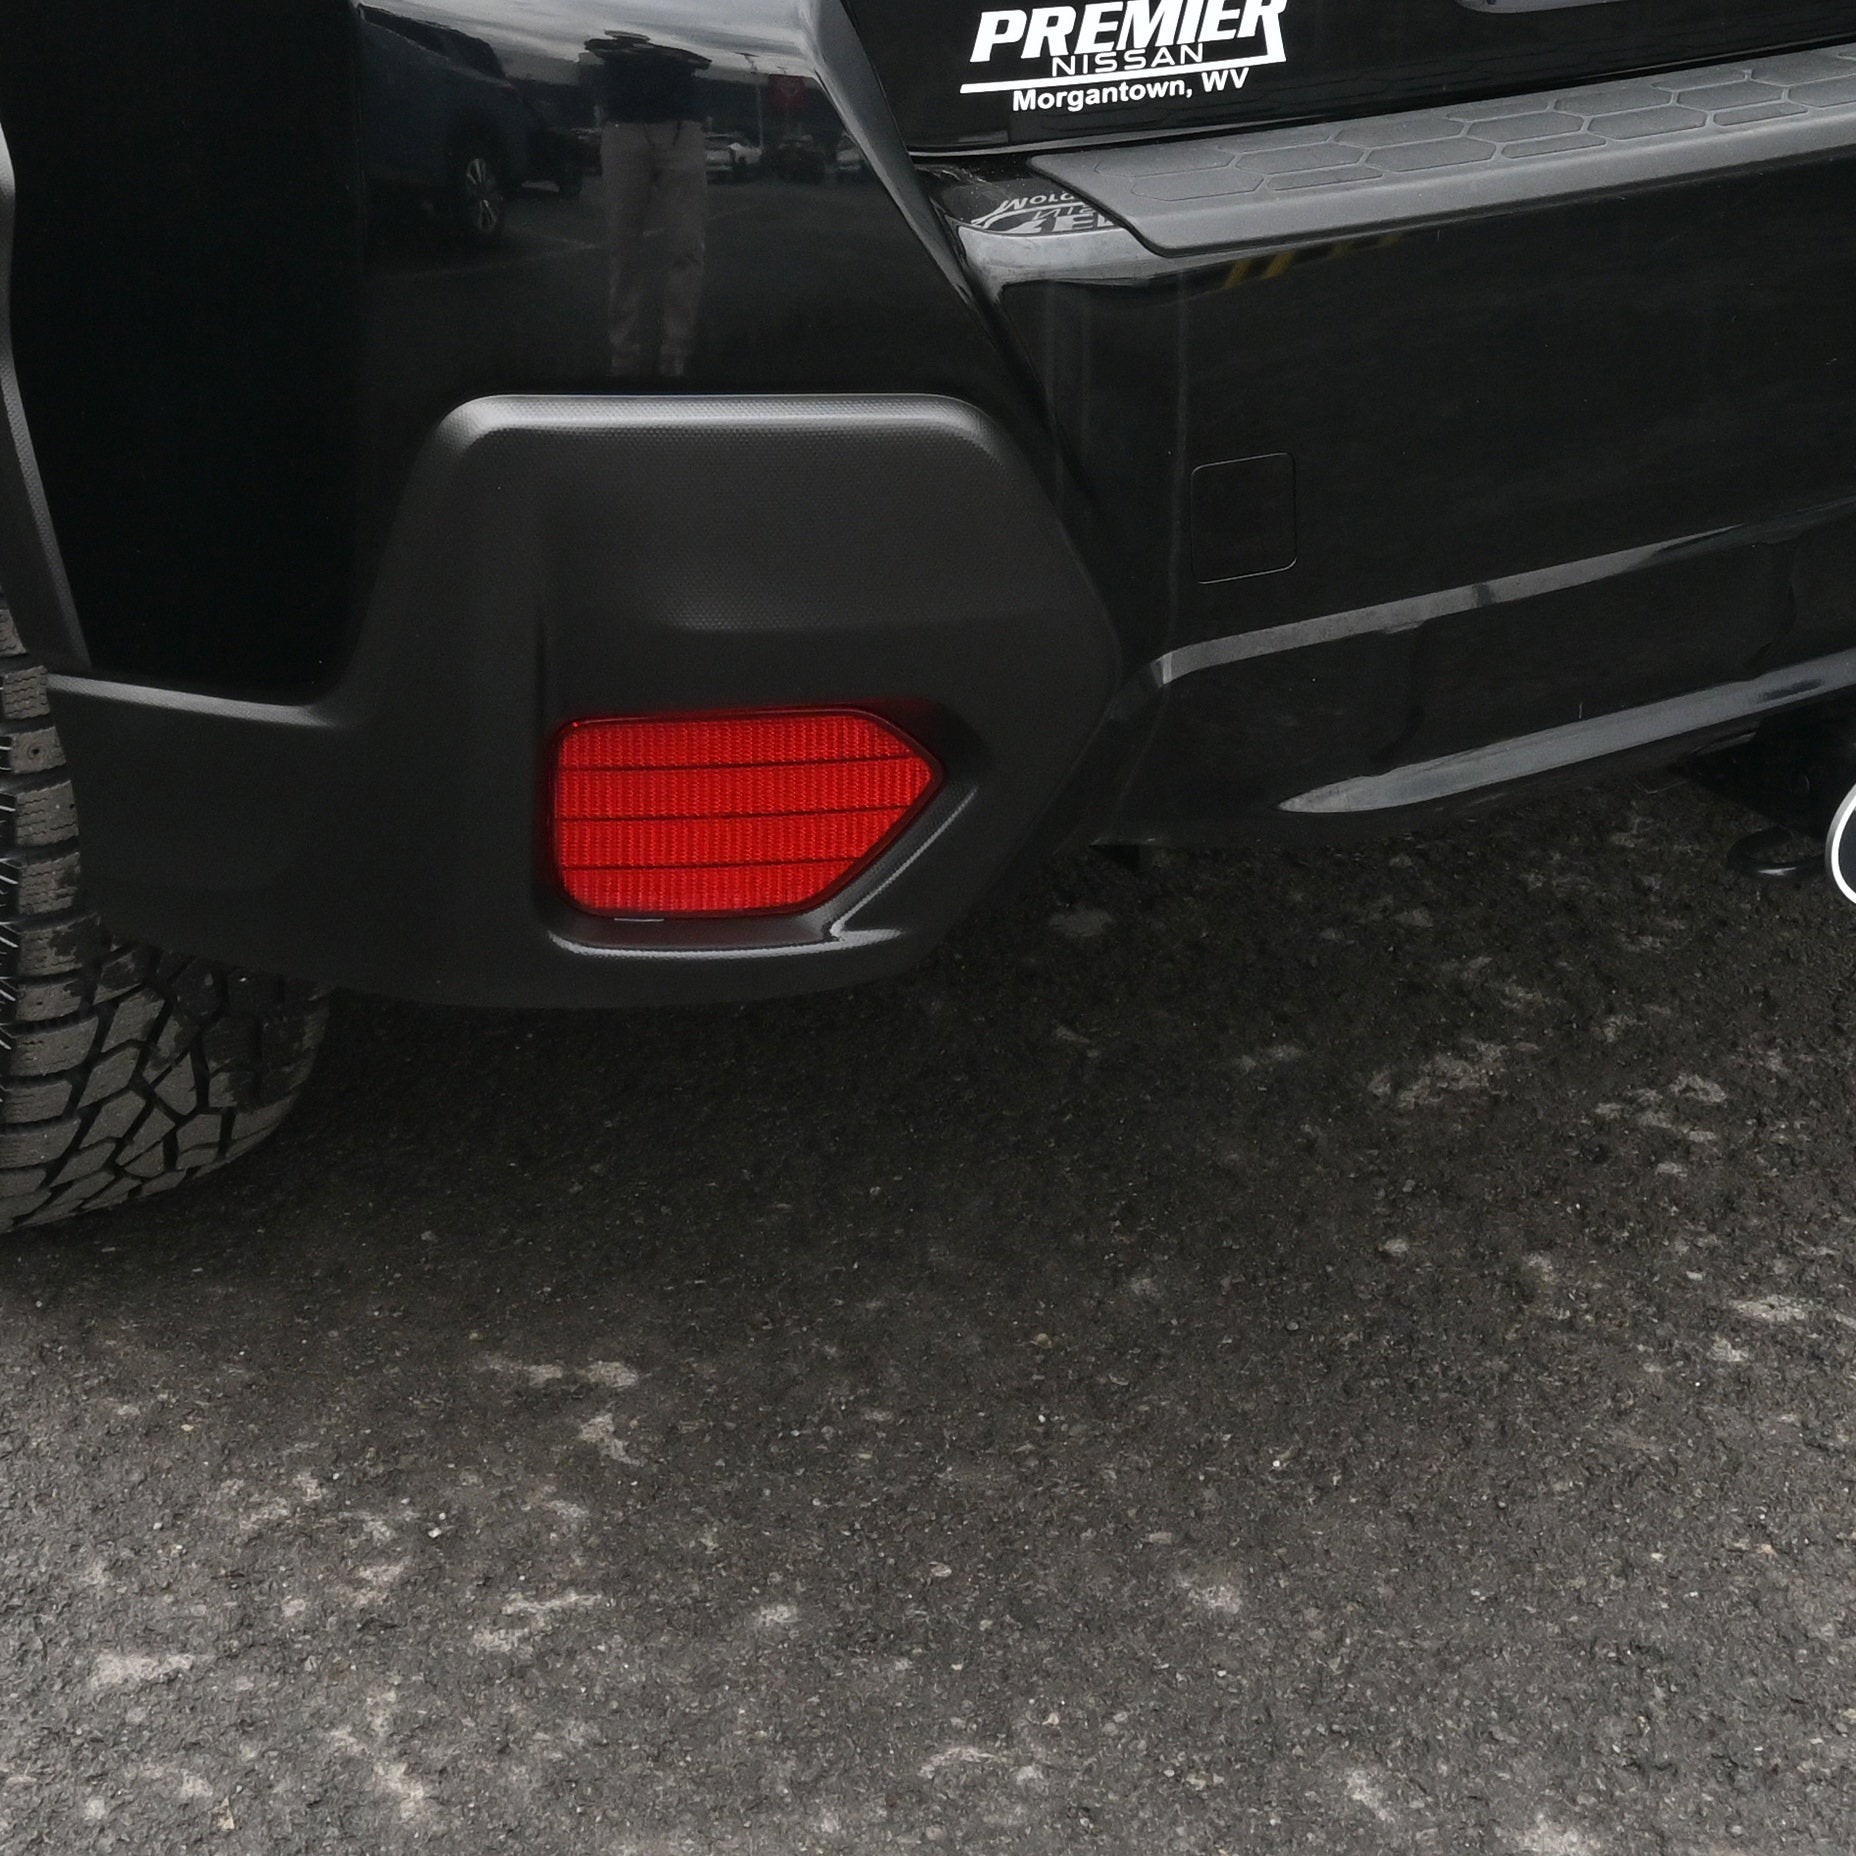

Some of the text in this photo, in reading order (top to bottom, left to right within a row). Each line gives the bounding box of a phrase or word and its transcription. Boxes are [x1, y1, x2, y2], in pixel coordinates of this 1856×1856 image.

[1051, 42, 1205, 77] NISSAN
[1012, 66, 1251, 112] Morgantown, WV
